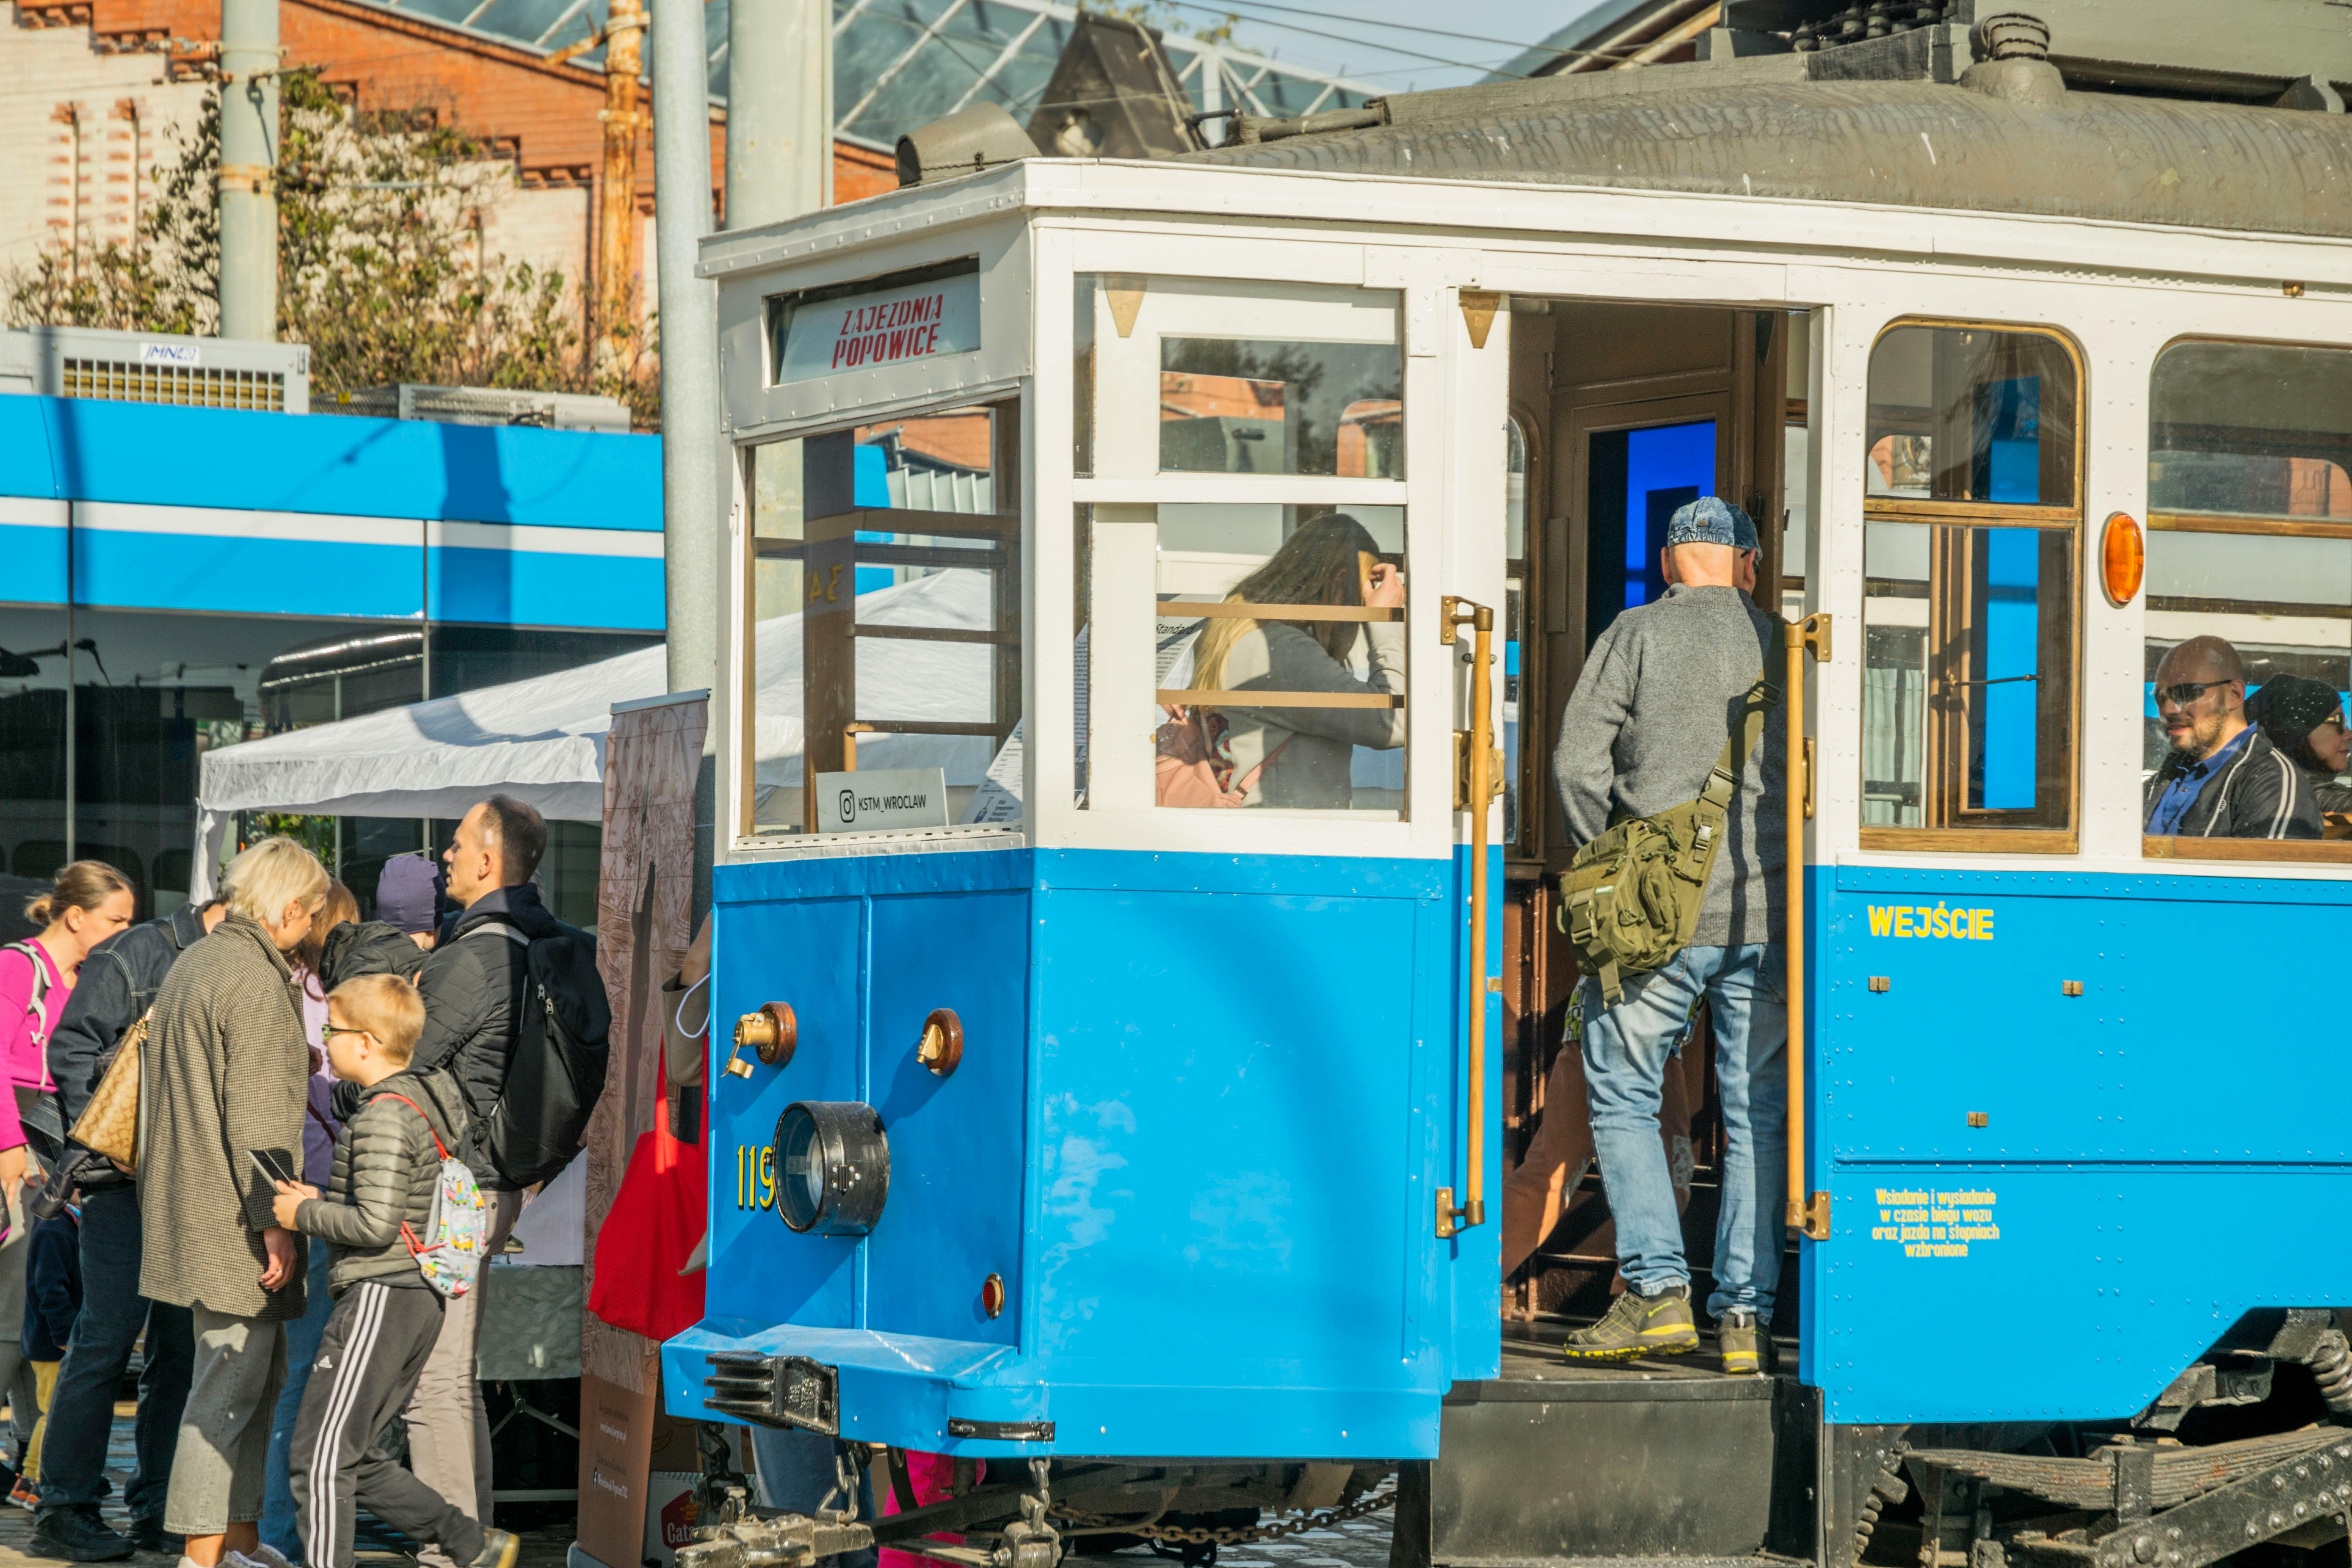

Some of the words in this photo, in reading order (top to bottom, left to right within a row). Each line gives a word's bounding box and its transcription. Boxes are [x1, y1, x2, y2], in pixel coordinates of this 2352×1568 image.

[840, 294, 943, 336] ZAJEZDNIA
[831, 323, 941, 369] POPOWICE
[1156, 623, 1197, 635] Standard
[858, 794, 926, 813] KSTM_WROCLAW
[1867, 901, 1994, 940] WEJŚCIE
[737, 1145, 776, 1212] 119
[1875, 1188, 1929, 1205] Wsiadanie
[1931, 1188, 1935, 1205] i
[1937, 1188, 1996, 1208] wysiadanie
[1880, 1209, 1891, 1222] w
[1893, 1206, 1929, 1222] czasie
[1930, 1206, 1960, 1226] biegu
[1962, 1209, 1992, 1222] wozu
[1872, 1227, 1898, 1240] oraz
[1898, 1223, 1930, 1243] jazda
[1932, 1227, 1946, 1240] na
[1948, 1223, 2000, 1243] stopniach
[1904, 1241, 1968, 1257] wzbronione
